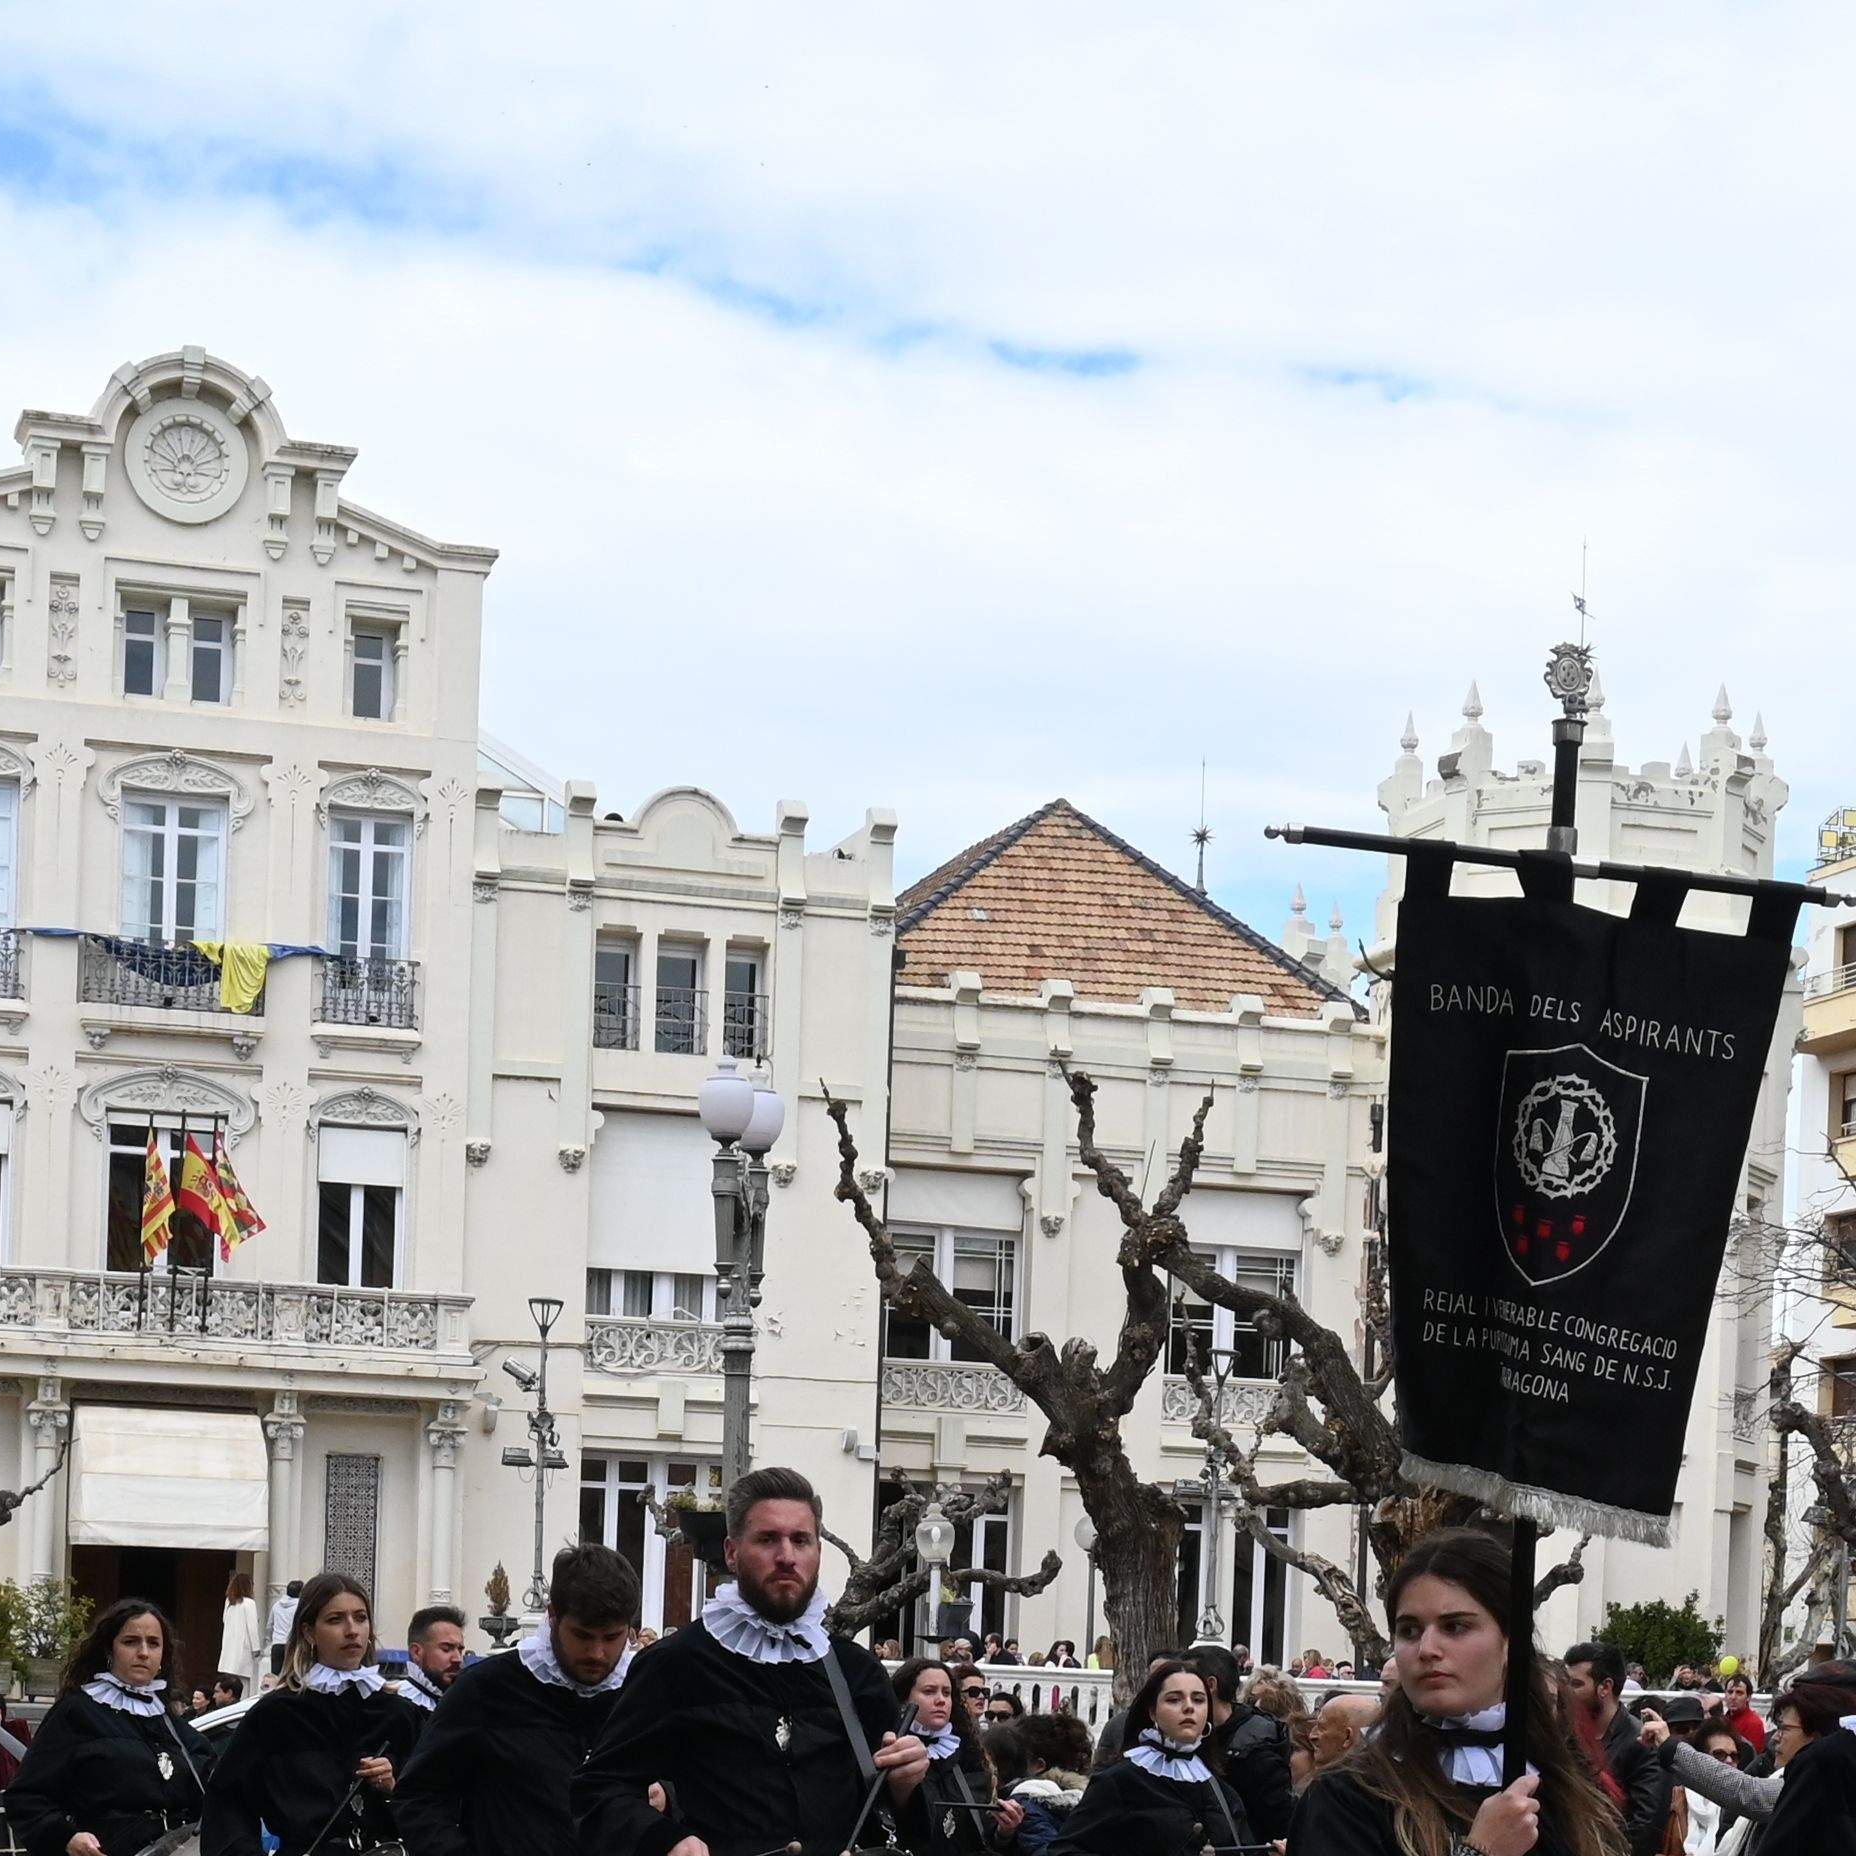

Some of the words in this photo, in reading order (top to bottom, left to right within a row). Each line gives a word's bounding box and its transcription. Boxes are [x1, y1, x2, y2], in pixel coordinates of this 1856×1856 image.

[1430, 984, 1514, 1016] BANDA
[1530, 994, 1581, 1023] DELS
[1600, 1008, 1736, 1061] ASPIRANTS
[1422, 1321, 1447, 1344] DE
[1453, 1326, 1476, 1348] LA
[1482, 1327, 1530, 1362] PURMA
[1540, 1343, 1587, 1373] SANG
[1593, 1355, 1618, 1381] DE
[1623, 1364, 1672, 1392] N.S.J.
[1423, 1288, 1477, 1316] REIAL
[1493, 1297, 1562, 1332] VEERABLE
[1564, 1315, 1678, 1360] CONGREGACIO
